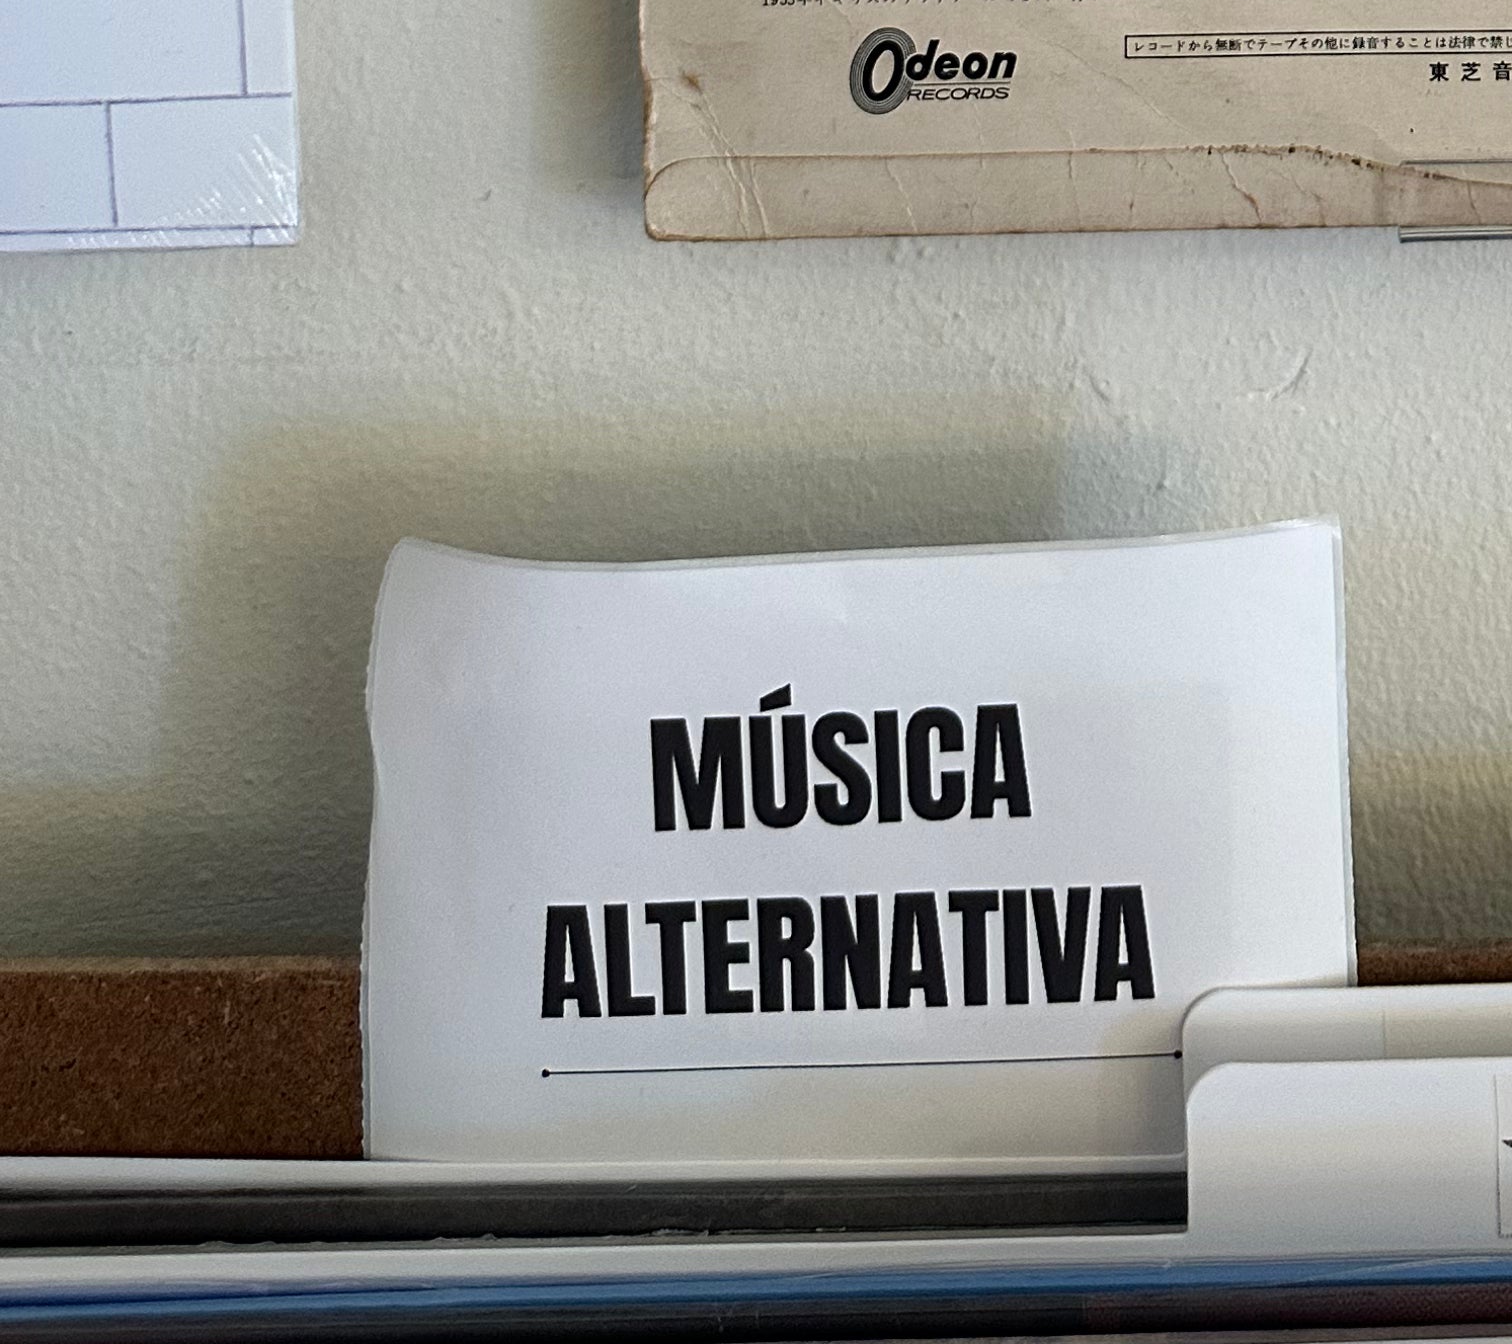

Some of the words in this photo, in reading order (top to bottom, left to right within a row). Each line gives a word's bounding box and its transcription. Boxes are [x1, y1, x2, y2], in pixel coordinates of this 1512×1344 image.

[857, 28, 1018, 112] Odeon
[906, 85, 1011, 102] RECORDS
[650, 683, 1033, 833] MÚSICA
[541, 885, 1156, 1019] ALTERNATIVA
